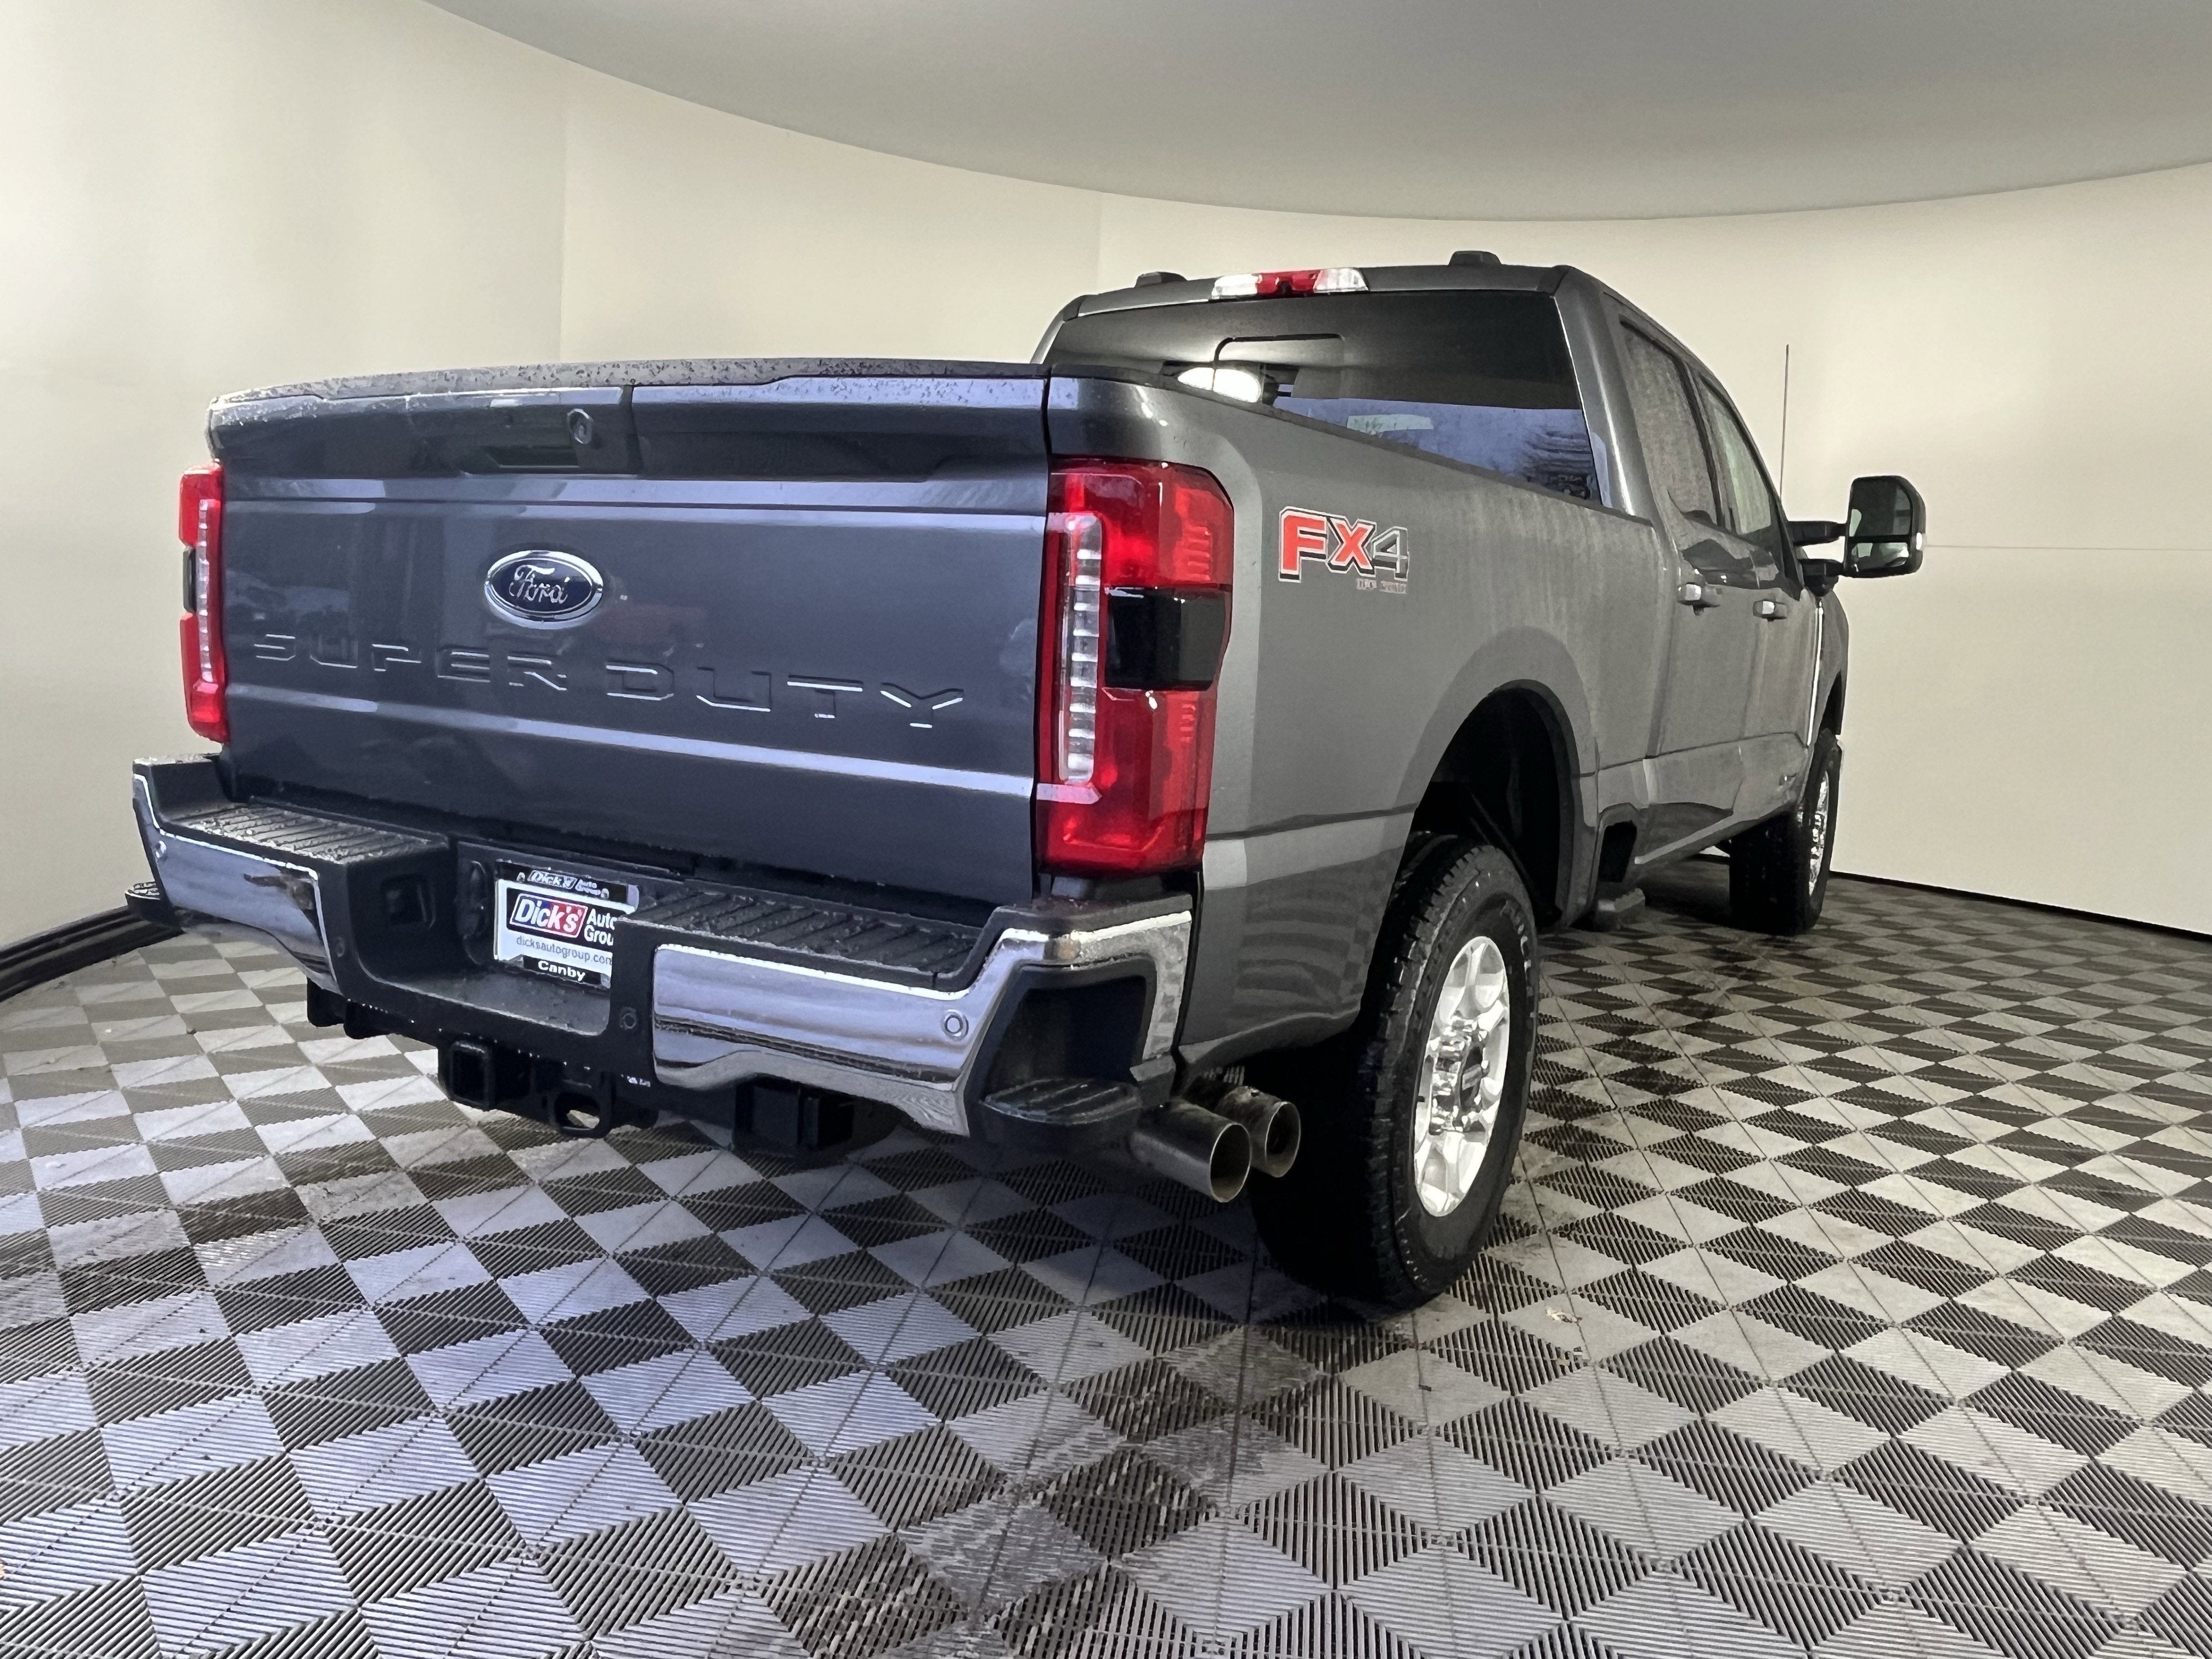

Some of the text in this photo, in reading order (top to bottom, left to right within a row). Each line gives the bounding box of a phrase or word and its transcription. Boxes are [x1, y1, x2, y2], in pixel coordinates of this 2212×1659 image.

[1279, 506, 1409, 583] FX4
[509, 565, 568, 603] Ford
[253, 633, 964, 728] SUPER DUTY
[515, 899, 582, 933] Dick's
[584, 924, 614, 946] Grou
[538, 960, 586, 981] Canby
